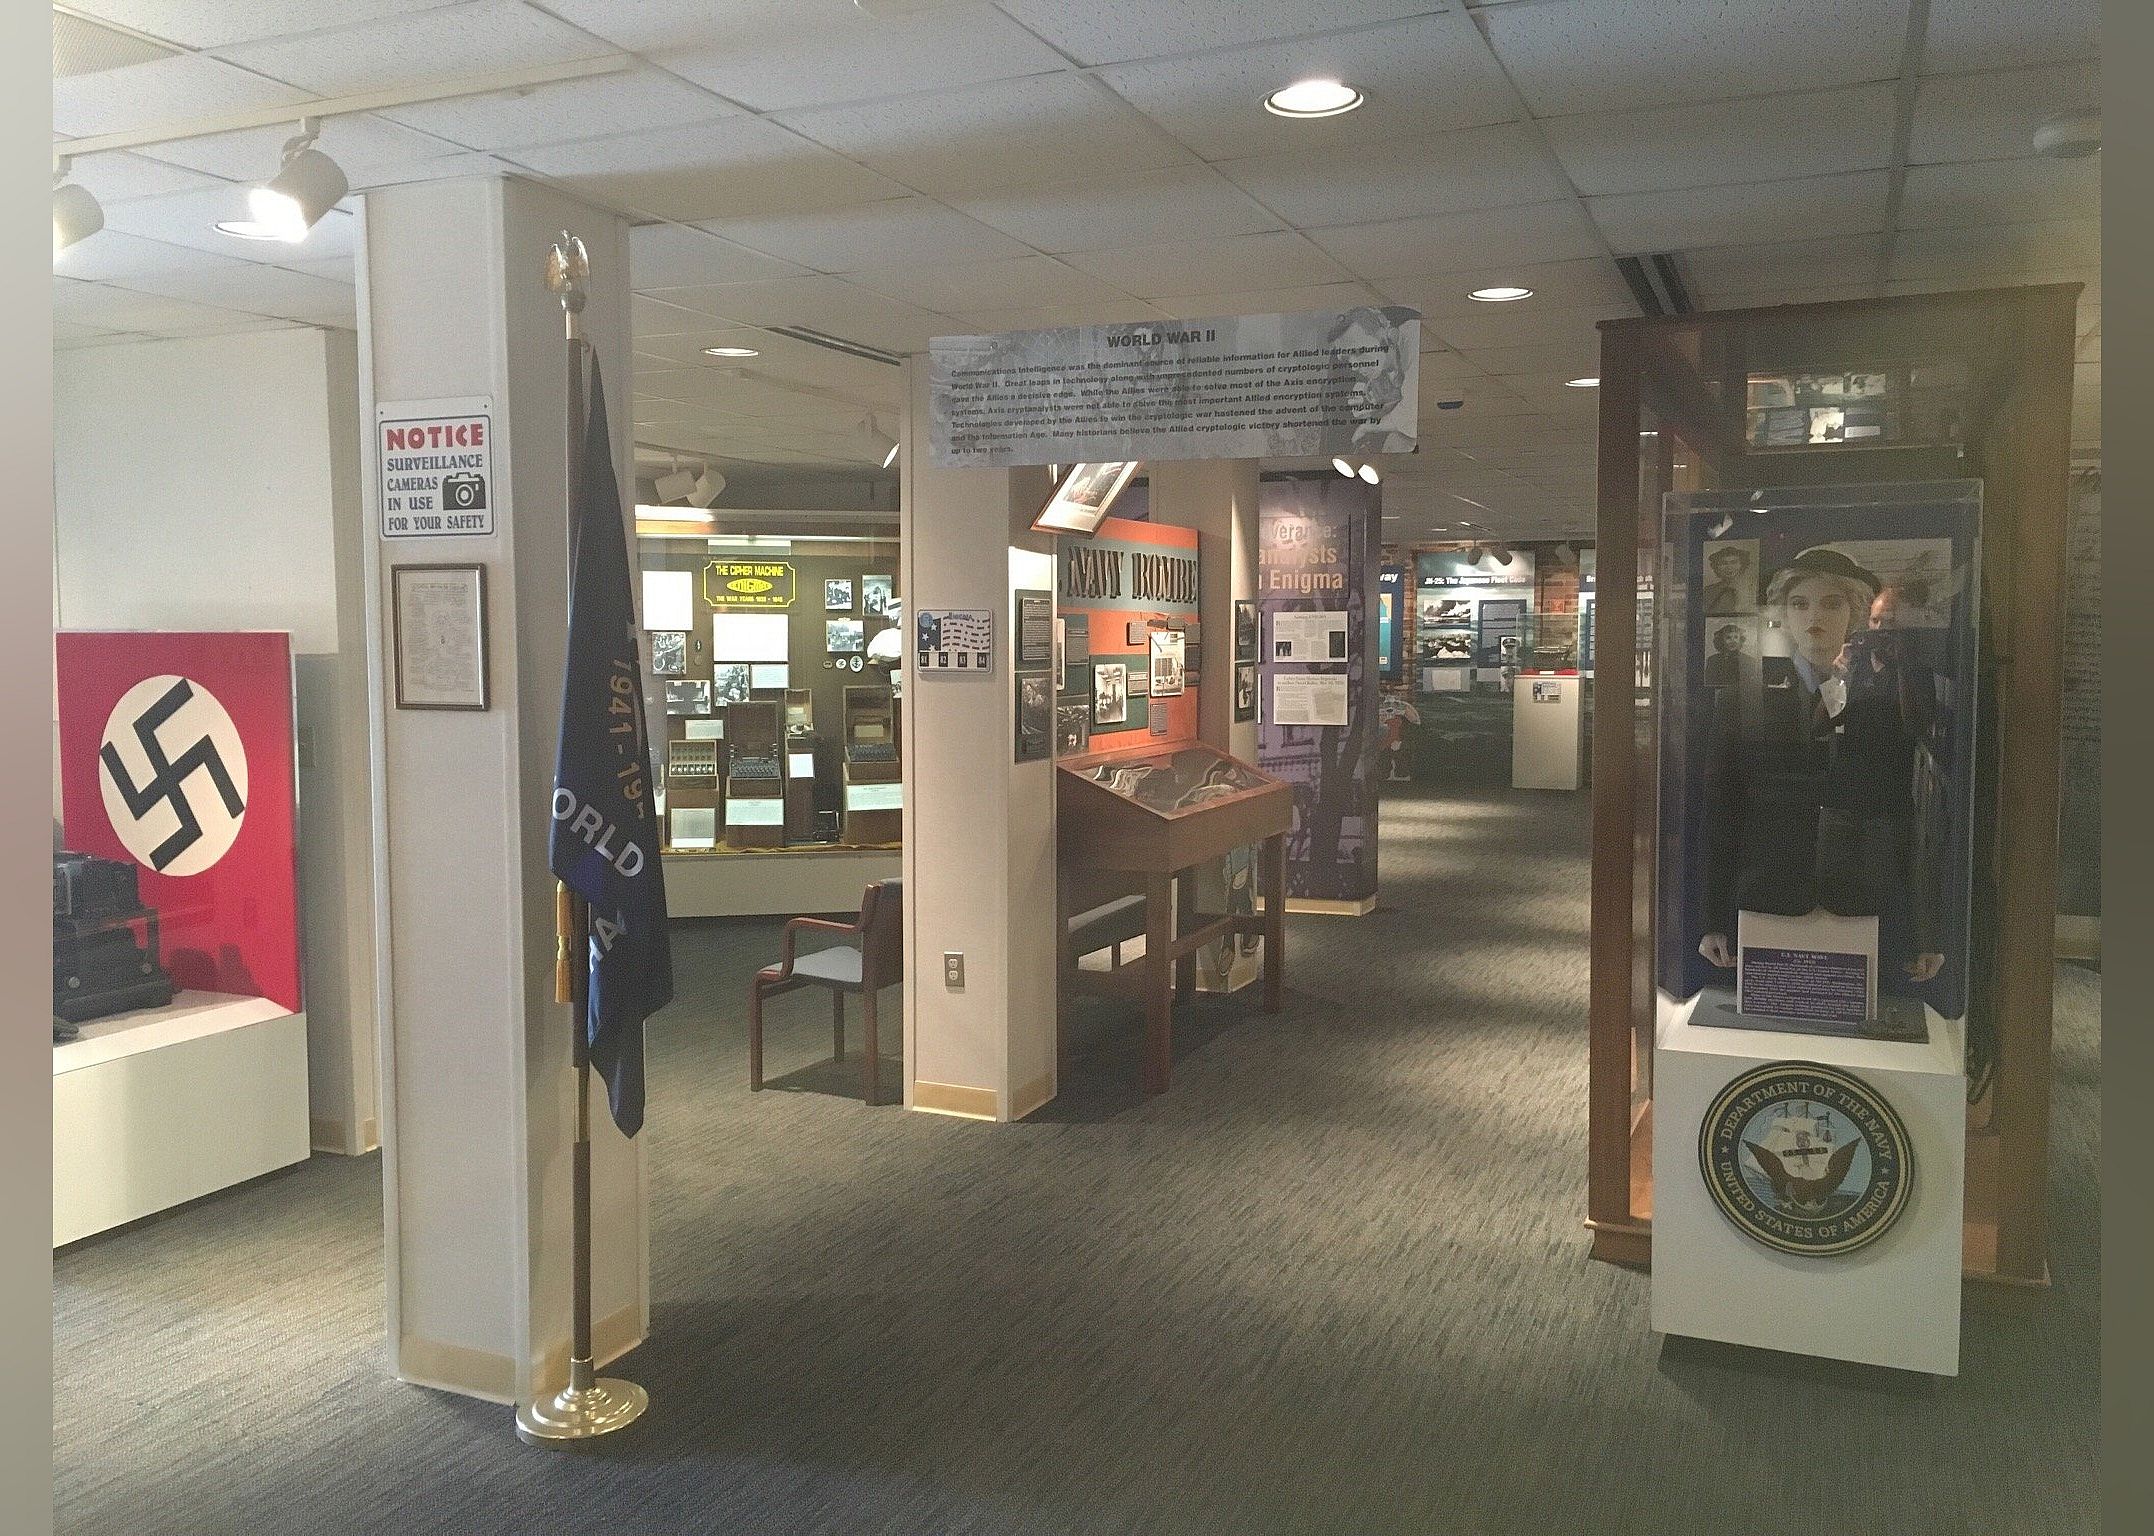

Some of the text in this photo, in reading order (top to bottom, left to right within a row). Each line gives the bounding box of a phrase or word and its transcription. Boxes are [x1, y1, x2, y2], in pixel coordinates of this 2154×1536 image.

[1107, 329, 1216, 348] WORLD WAR II
[952, 368, 1016, 378] Communications
[1018, 364, 1066, 374] Intelligence
[1104, 360, 1142, 369] dominant
[1177, 357, 1185, 365] of
[1188, 354, 1220, 364] reliable
[1223, 350, 1275, 362] information
[1278, 350, 1290, 359] for
[1292, 348, 1319, 358] Allied
[1321, 346, 1358, 356] leaders
[1359, 344, 1389, 354] during
[952, 382, 974, 390] World
[1005, 380, 1026, 388] Great
[1029, 379, 1050, 388] leaps
[1062, 374, 1108, 384] technology
[1110, 374, 1134, 384] along
[1136, 372, 1155, 380] with
[1156, 368, 1222, 380] unprecedented
[1224, 366, 1264, 376] numbers
[1266, 366, 1276, 374] of
[1278, 364, 1329, 375] cryptologic
[1332, 360, 1379, 370] personnel
[952, 396, 970, 404] gave
[972, 394, 984, 402] the
[1018, 392, 1050, 400] decisive
[1053, 391, 1076, 400] edge.
[1106, 388, 1120, 396] the
[1122, 386, 1145, 395] Allies
[1172, 384, 1190, 393] able
[1192, 384, 1201, 392] to
[1204, 382, 1228, 391] solve
[1230, 382, 1252, 390] most
[1254, 380, 1264, 388] of
[1266, 379, 1281, 387] the
[1284, 378, 1304, 386] Axis
[1306, 375, 1356, 386] encryption
[1007, 404, 1062, 414] cryptanalysts
[1086, 402, 1100, 410] not
[1133, 400, 1156, 408] solve
[1158, 398, 1172, 406] the
[1174, 398, 1196, 406] most
[1199, 396, 1242, 406] important
[1244, 393, 1270, 402] Allied
[1273, 390, 1322, 402] encryption
[1324, 390, 1366, 400] systems.
[952, 420, 1002, 429] Technologies
[1004, 418, 1044, 427] developed
[1046, 418, 1056, 426] by
[1074, 416, 1097, 424] Allies
[1111, 414, 1126, 422] win
[1144, 412, 1193, 422] cryptologic
[1214, 408, 1256, 417] hastened
[1258, 408, 1273, 416] the
[1276, 406, 1306, 414] advent
[1321, 404, 1337, 412] the
[1340, 402, 1384, 412] computer
[386, 423, 484, 451] NOTICE
[952, 434, 966, 442] and
[982, 432, 1028, 440] Information
[1030, 432, 1048, 440] Age.
[1052, 430, 1074, 438] Many
[1076, 428, 1118, 436] historians
[1120, 428, 1150, 436] believe
[1152, 426, 1166, 434] the
[1196, 422, 1246, 432] cryptologic
[1248, 420, 1280, 430] victory
[1282, 418, 1329, 428] shortened
[1332, 418, 1347, 426] the
[1370, 416, 1382, 425] by
[387, 454, 483, 472] SURVEILLANCE
[990, 446, 1014, 454] years.
[387, 476, 438, 492] CAMERAS
[388, 496, 433, 511] IN USE
[388, 514, 484, 531] FOR YOUR SAFETY
[716, 566, 783, 576] THE CIPHER MACHINE
[1067, 546, 1124, 598] NAVY
[1270, 570, 1343, 593] Enigma
[608, 658, 633, 734] 1941
[552, 787, 645, 878] ORLD
[1720, 1081, 1893, 1160] DEPARTMENT OF THE NAVY
[1721, 1160, 1890, 1239] UNITED STATES OF AMERICA
